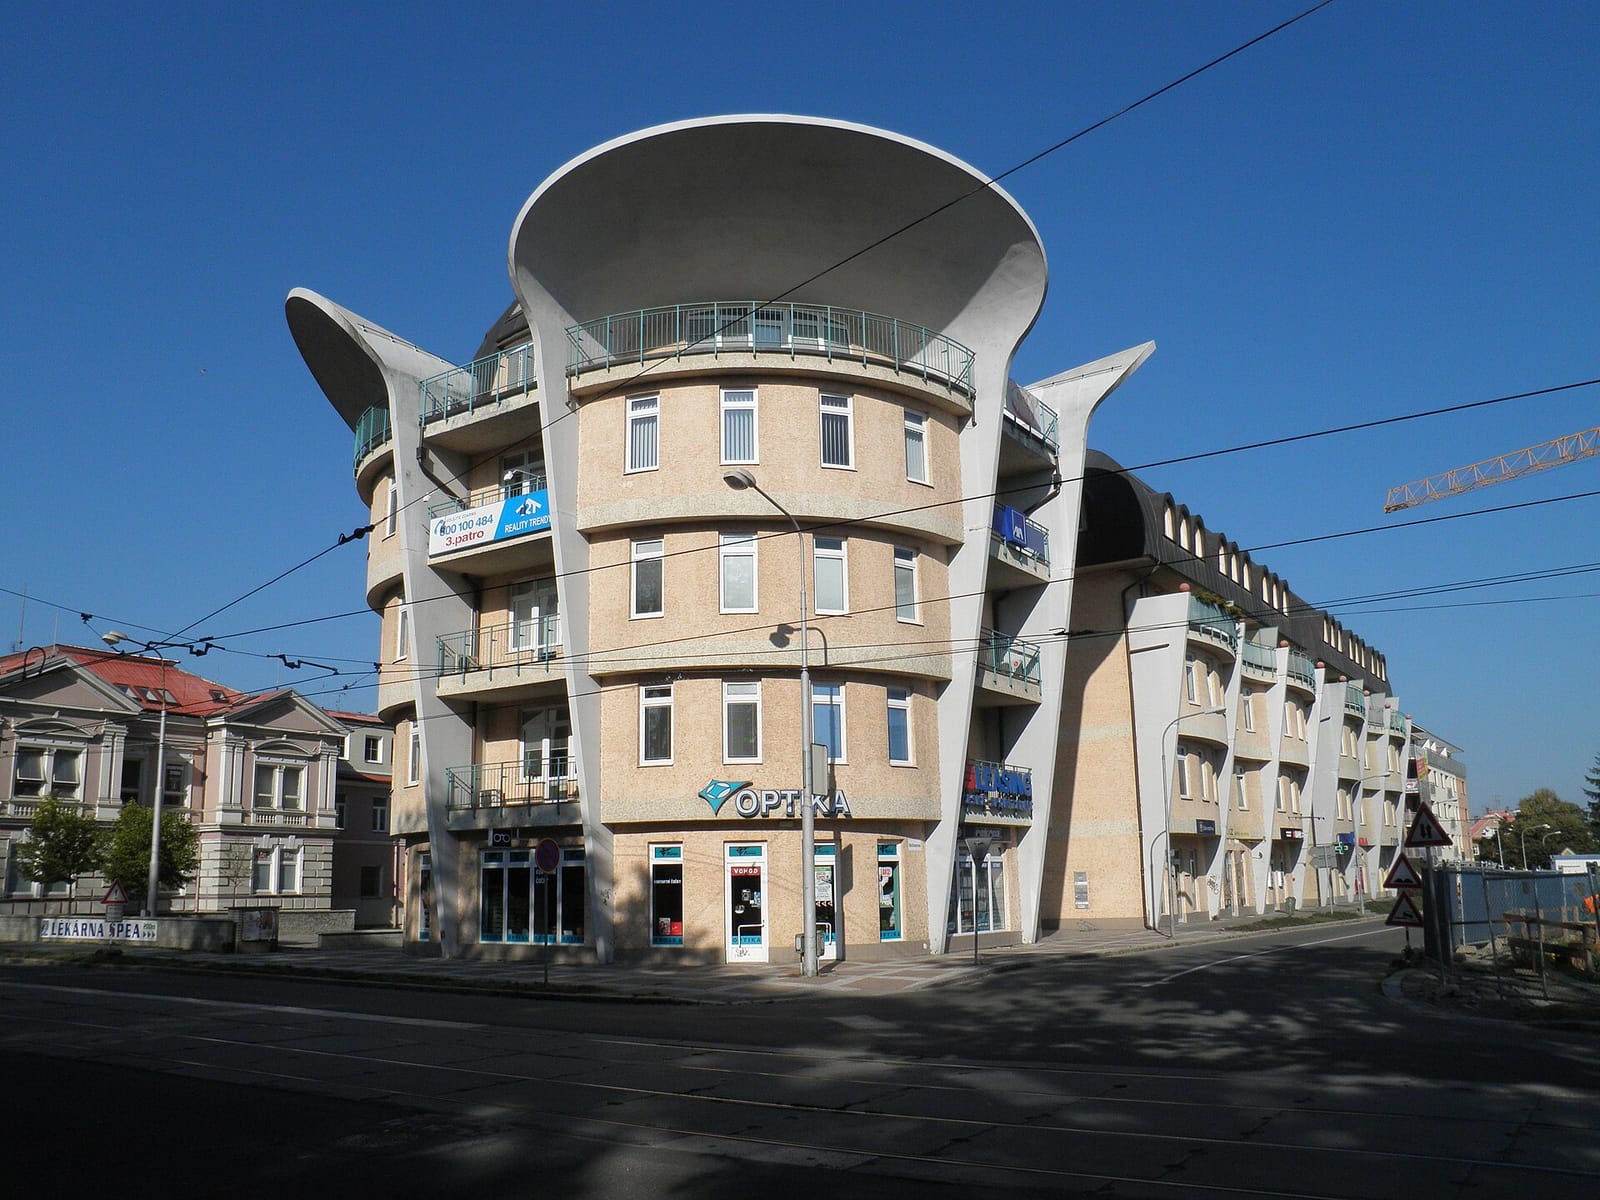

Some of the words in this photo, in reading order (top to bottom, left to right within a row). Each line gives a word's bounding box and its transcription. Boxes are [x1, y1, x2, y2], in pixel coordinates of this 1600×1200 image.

[458, 519, 474, 532] 100
[475, 514, 493, 527] 484
[504, 520, 528, 533] REALITY
[445, 530, 484, 546] 3.patro
[735, 788, 852, 818] OPTKA
[51, 920, 104, 937] LÉKÁRNA
